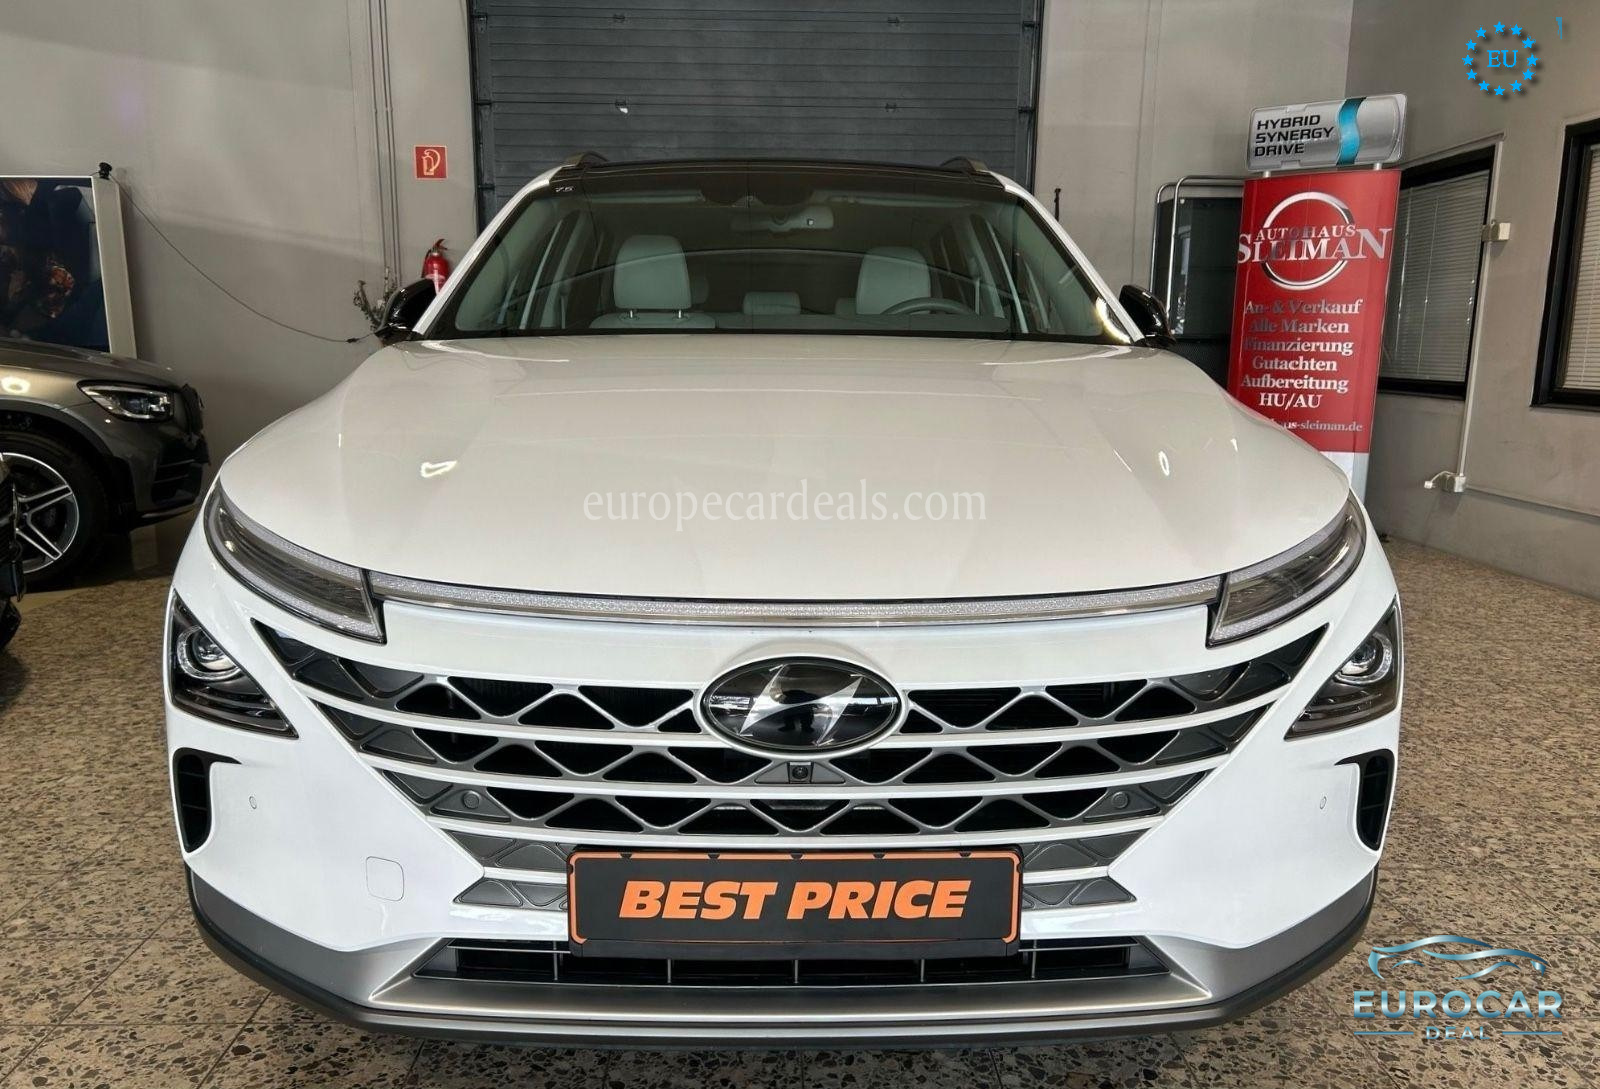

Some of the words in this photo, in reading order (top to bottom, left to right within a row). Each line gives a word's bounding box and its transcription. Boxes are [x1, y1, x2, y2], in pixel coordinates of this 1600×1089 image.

[1257, 115, 1320, 130] HYBRID
[1255, 127, 1334, 143] SYNERGY
[1254, 143, 1305, 157] DRIVE
[1256, 224, 1356, 241] AUTOHAUS
[1237, 228, 1392, 263] SLEIMAN
[1244, 301, 1269, 314] An-
[1273, 300, 1285, 314] &
[1289, 299, 1363, 314] Verkauf
[1281, 318, 1349, 333] Marken
[1245, 337, 1354, 356] Finanzierung
[1252, 355, 1337, 371] Gutachten
[1241, 374, 1349, 393] Aufbereitung
[1259, 392, 1322, 410] HU/AU
[619, 880, 778, 919] BEST
[786, 880, 972, 919] PRICE
